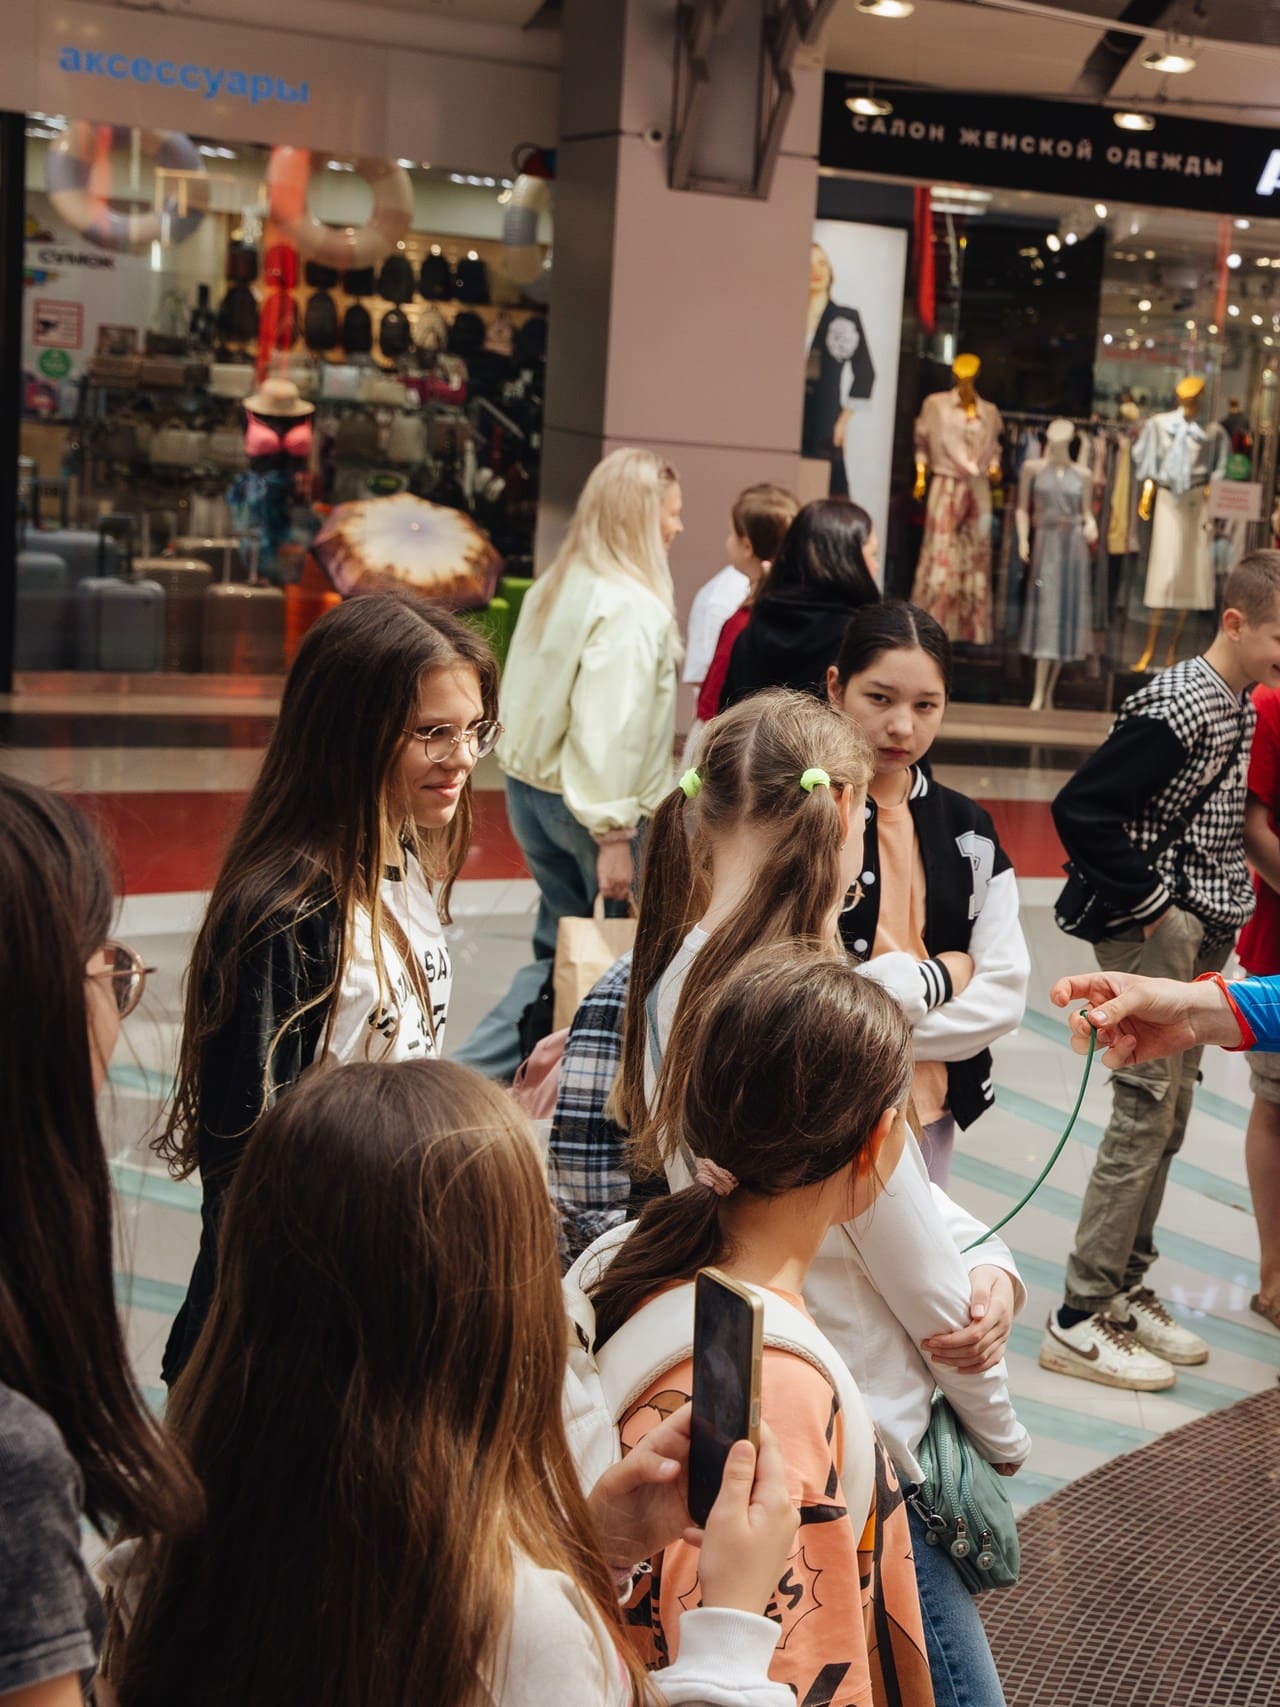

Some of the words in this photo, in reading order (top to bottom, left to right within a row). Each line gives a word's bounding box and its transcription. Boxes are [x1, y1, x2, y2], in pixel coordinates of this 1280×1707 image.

[58, 46, 309, 105] аксессуары
[852, 114, 945, 143] САЛОН
[959, 127, 1093, 160] ЖЕНСКОЙ
[1106, 146, 1224, 178] ОДЕЖДЫ
